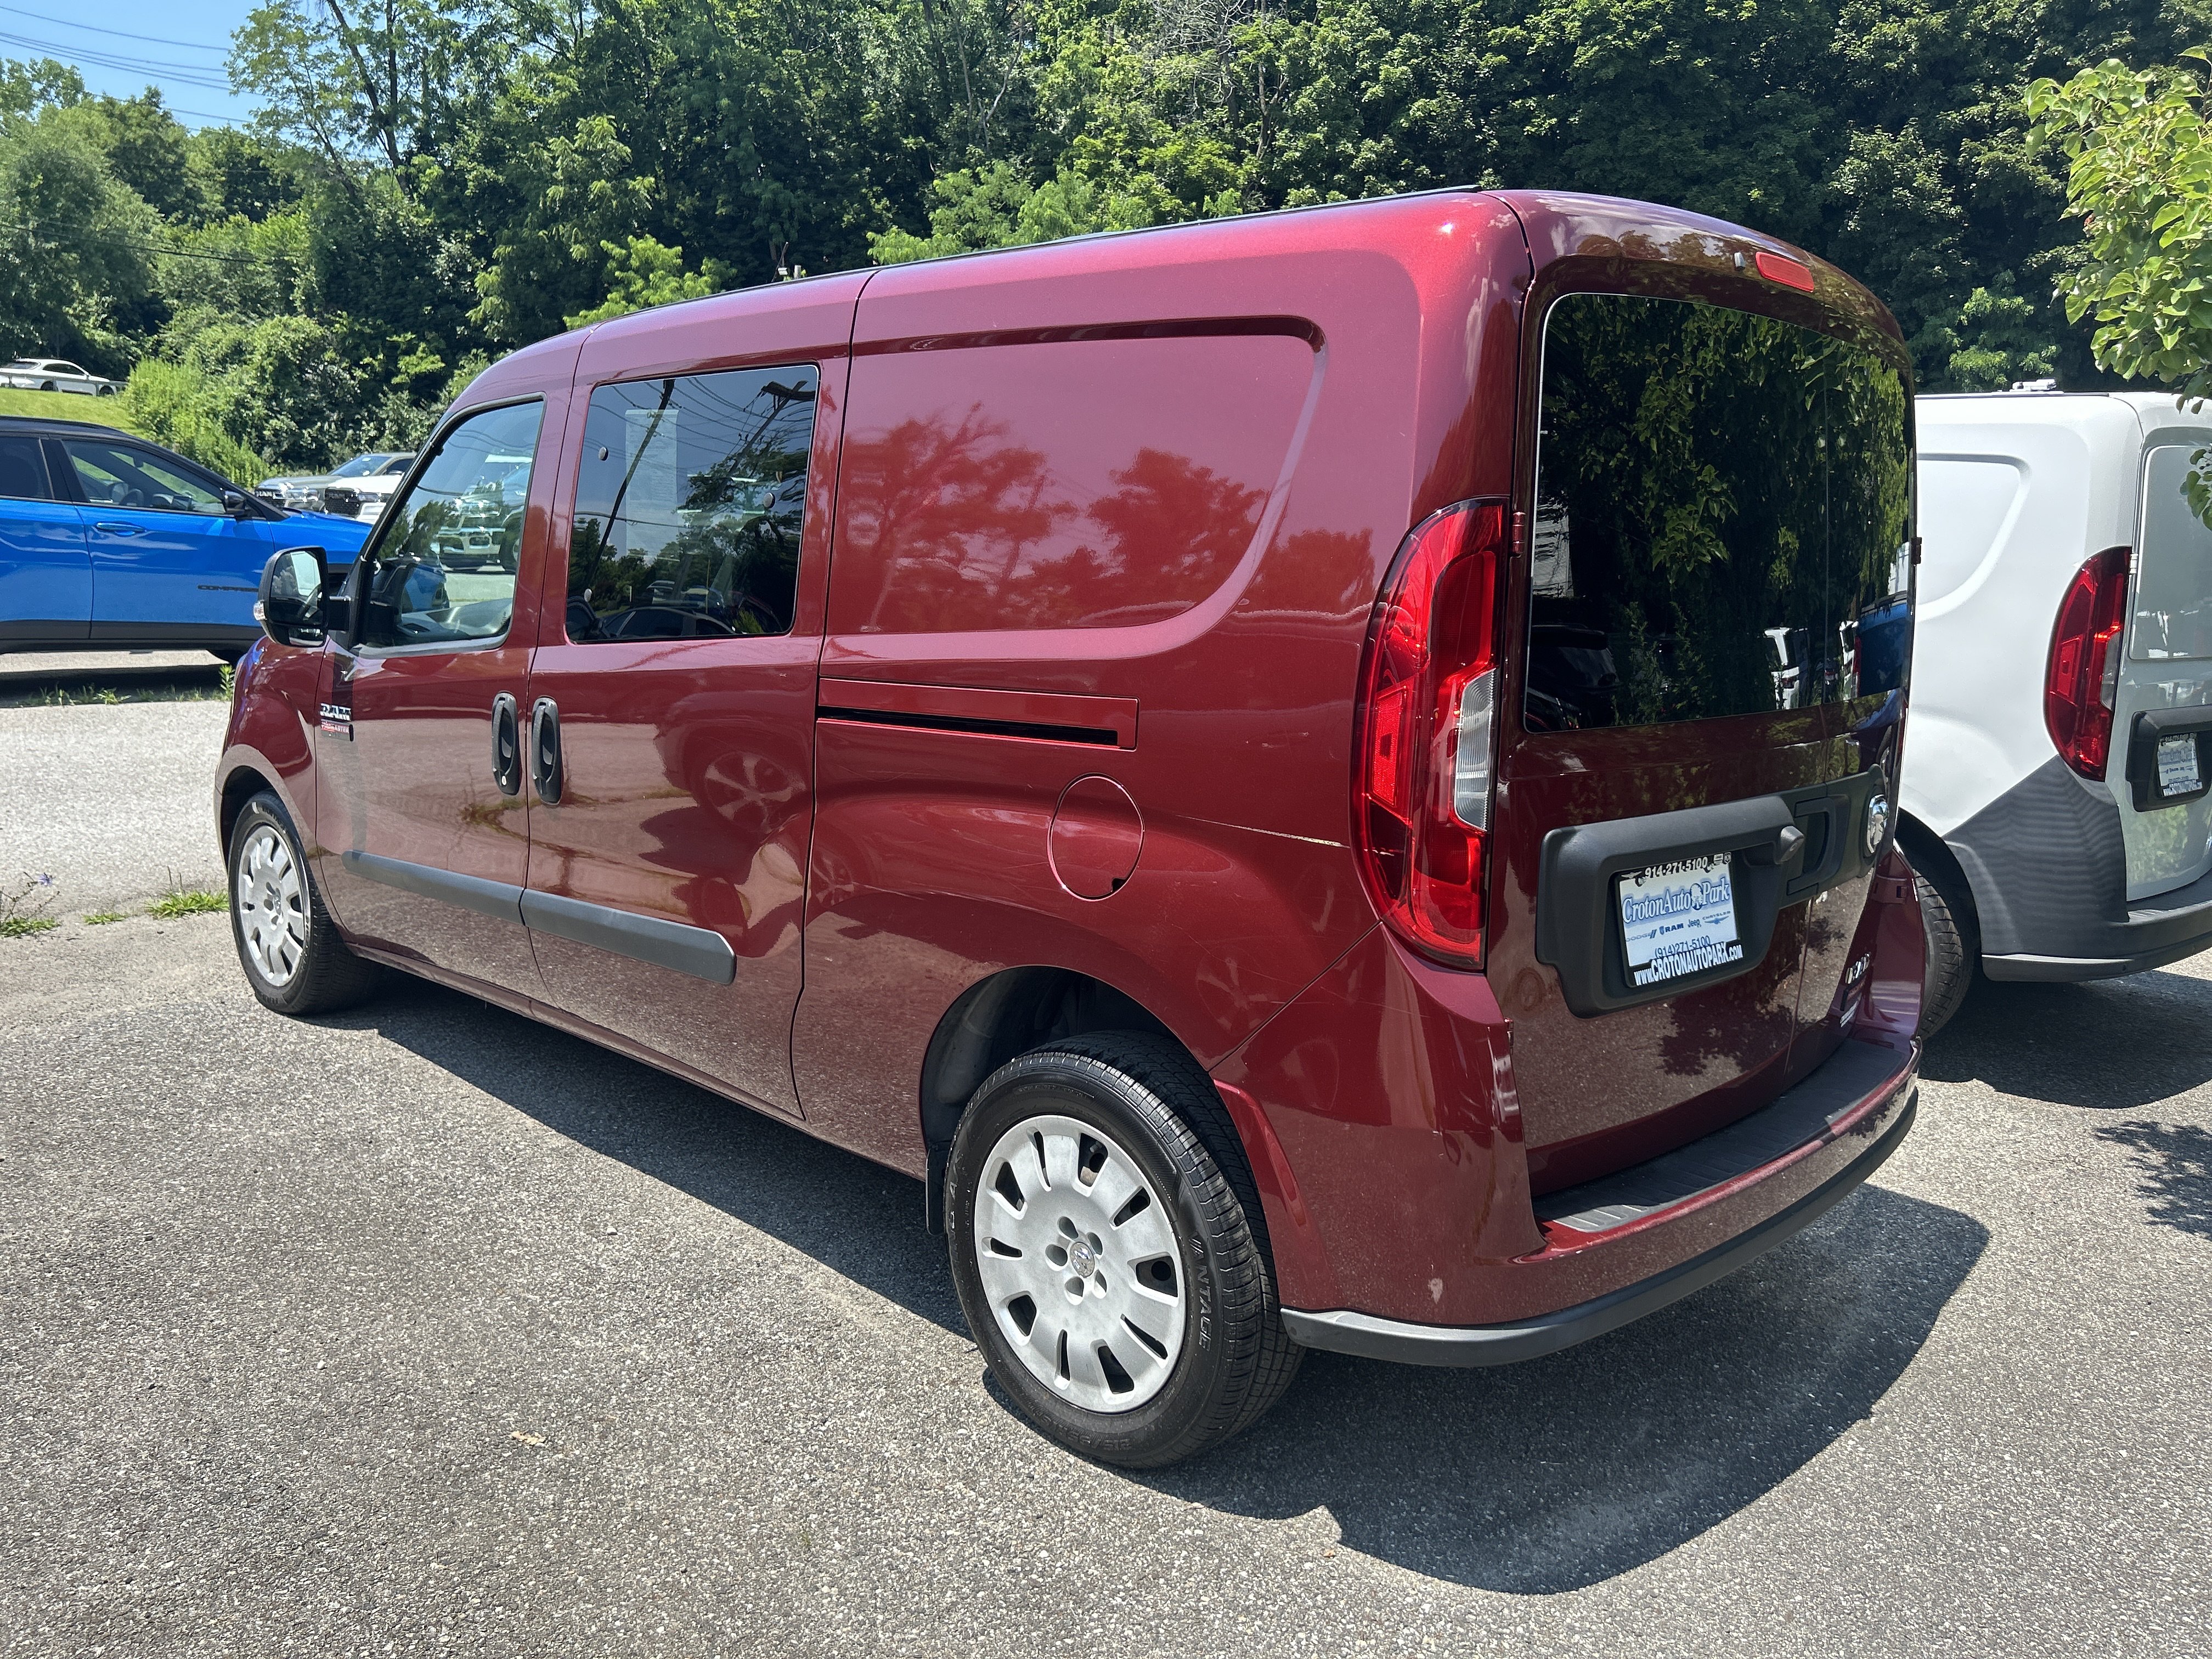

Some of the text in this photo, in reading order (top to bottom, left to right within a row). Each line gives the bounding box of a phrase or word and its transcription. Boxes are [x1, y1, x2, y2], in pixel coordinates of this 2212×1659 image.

[1701, 876, 1730, 906] Park
[1702, 911, 1731, 921] CHRYSLER
[1664, 923, 1684, 933] RAM
[1688, 918, 1701, 928] Jeep
